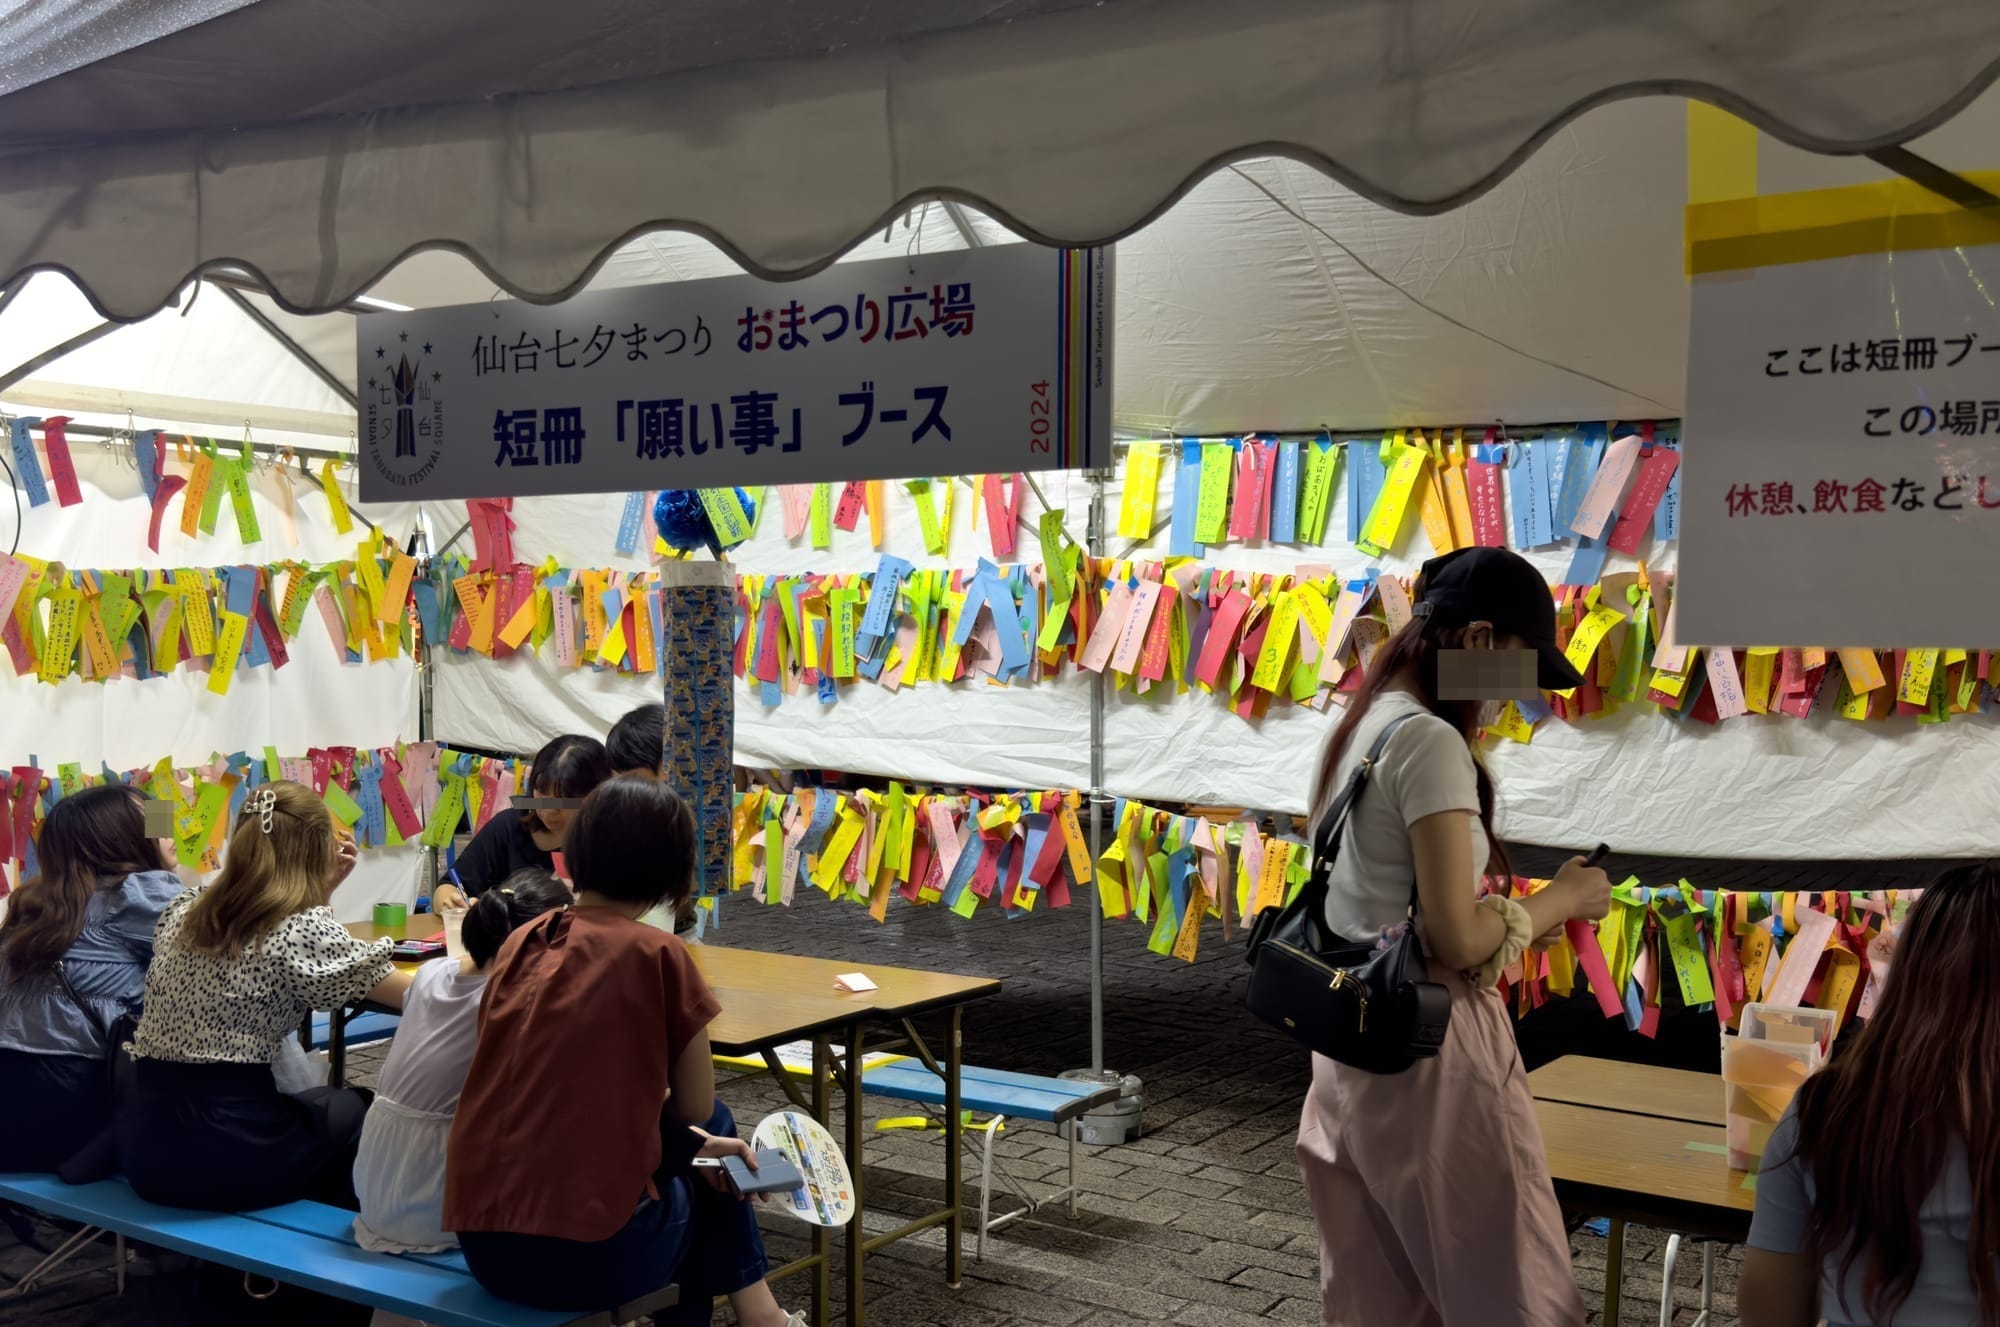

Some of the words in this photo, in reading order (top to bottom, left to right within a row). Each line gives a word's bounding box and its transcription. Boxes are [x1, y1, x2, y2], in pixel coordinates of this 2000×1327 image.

[473, 316, 713, 377] 仙台七夕まつり
[737, 282, 976, 353] おまつり広場
[1765, 333, 2000, 377] ここは短冊ブー
[368, 403, 377, 446] SENDAI
[408, 449, 441, 486] FESTIVAL
[1030, 379, 1052, 454] 2024
